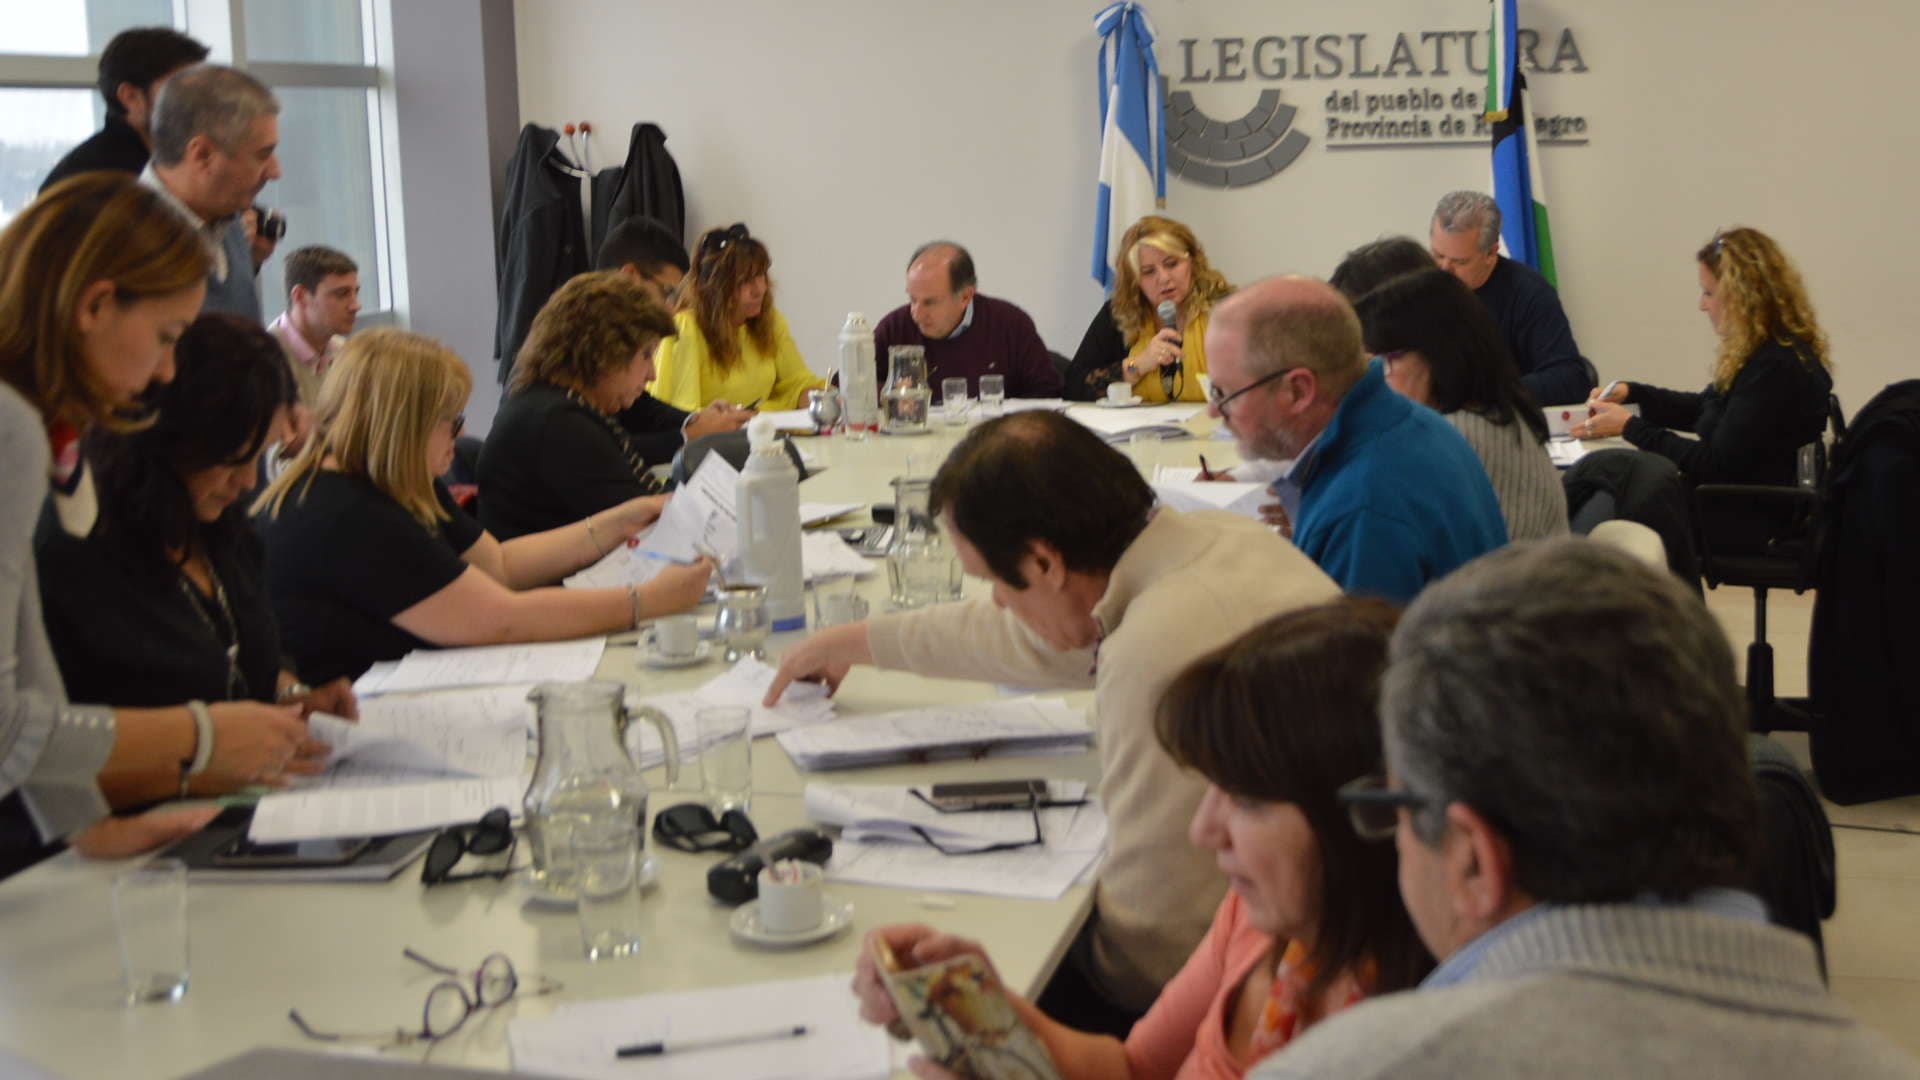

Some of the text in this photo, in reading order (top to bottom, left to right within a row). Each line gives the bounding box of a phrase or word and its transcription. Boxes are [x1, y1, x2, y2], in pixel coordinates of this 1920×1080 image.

[1178, 28, 1588, 83] LEGISLATURA
[1325, 90, 1359, 112] del
[1365, 88, 1443, 117] pueblo
[1451, 86, 1477, 109] de
[1326, 114, 1432, 138] Provincia
[1440, 114, 1466, 136] de
[1535, 115, 1587, 137] egro
